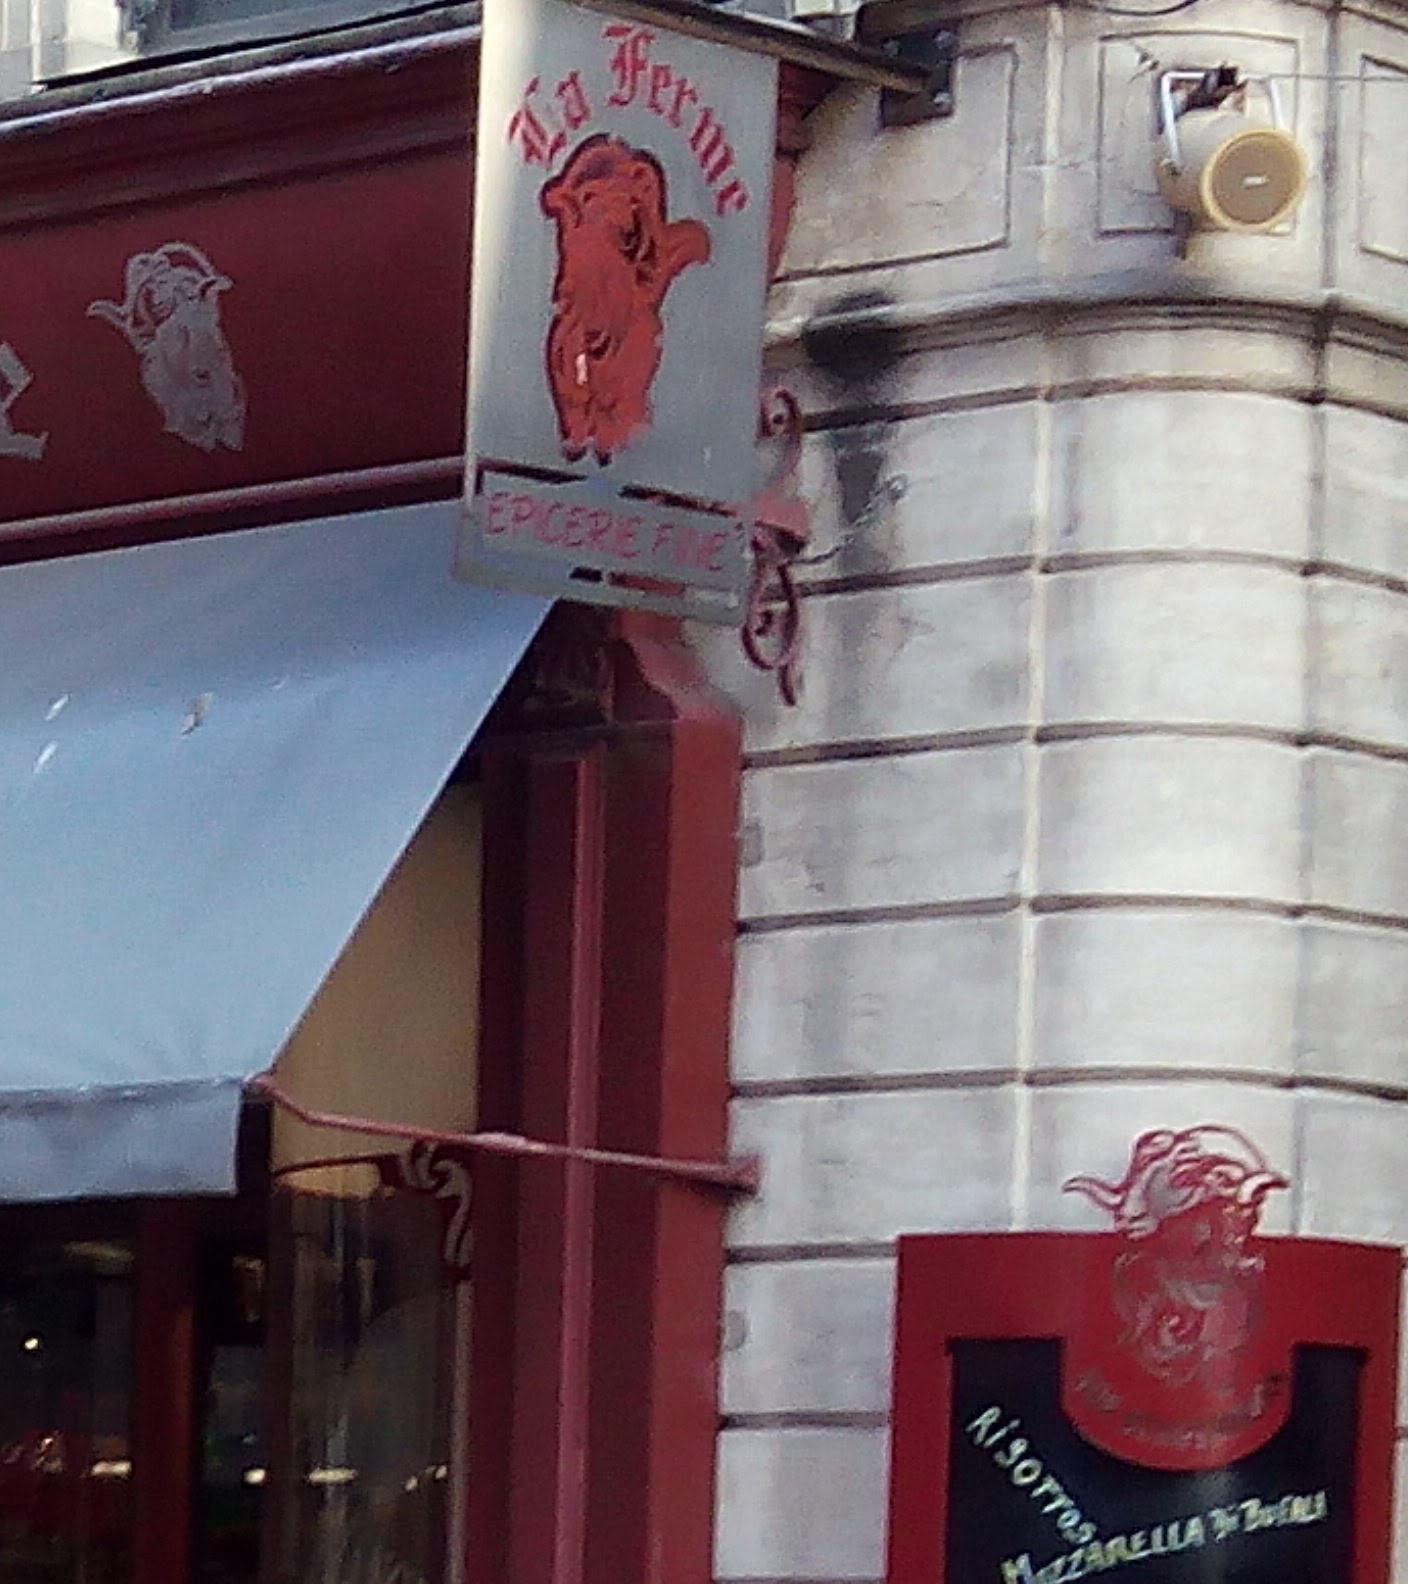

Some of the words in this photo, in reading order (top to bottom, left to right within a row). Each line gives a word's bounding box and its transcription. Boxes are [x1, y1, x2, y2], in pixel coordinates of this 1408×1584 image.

[507, 71, 591, 169] La
[602, 25, 749, 217] Ferme
[487, 491, 643, 559] EPICERIE
[651, 522, 730, 572] FINE
